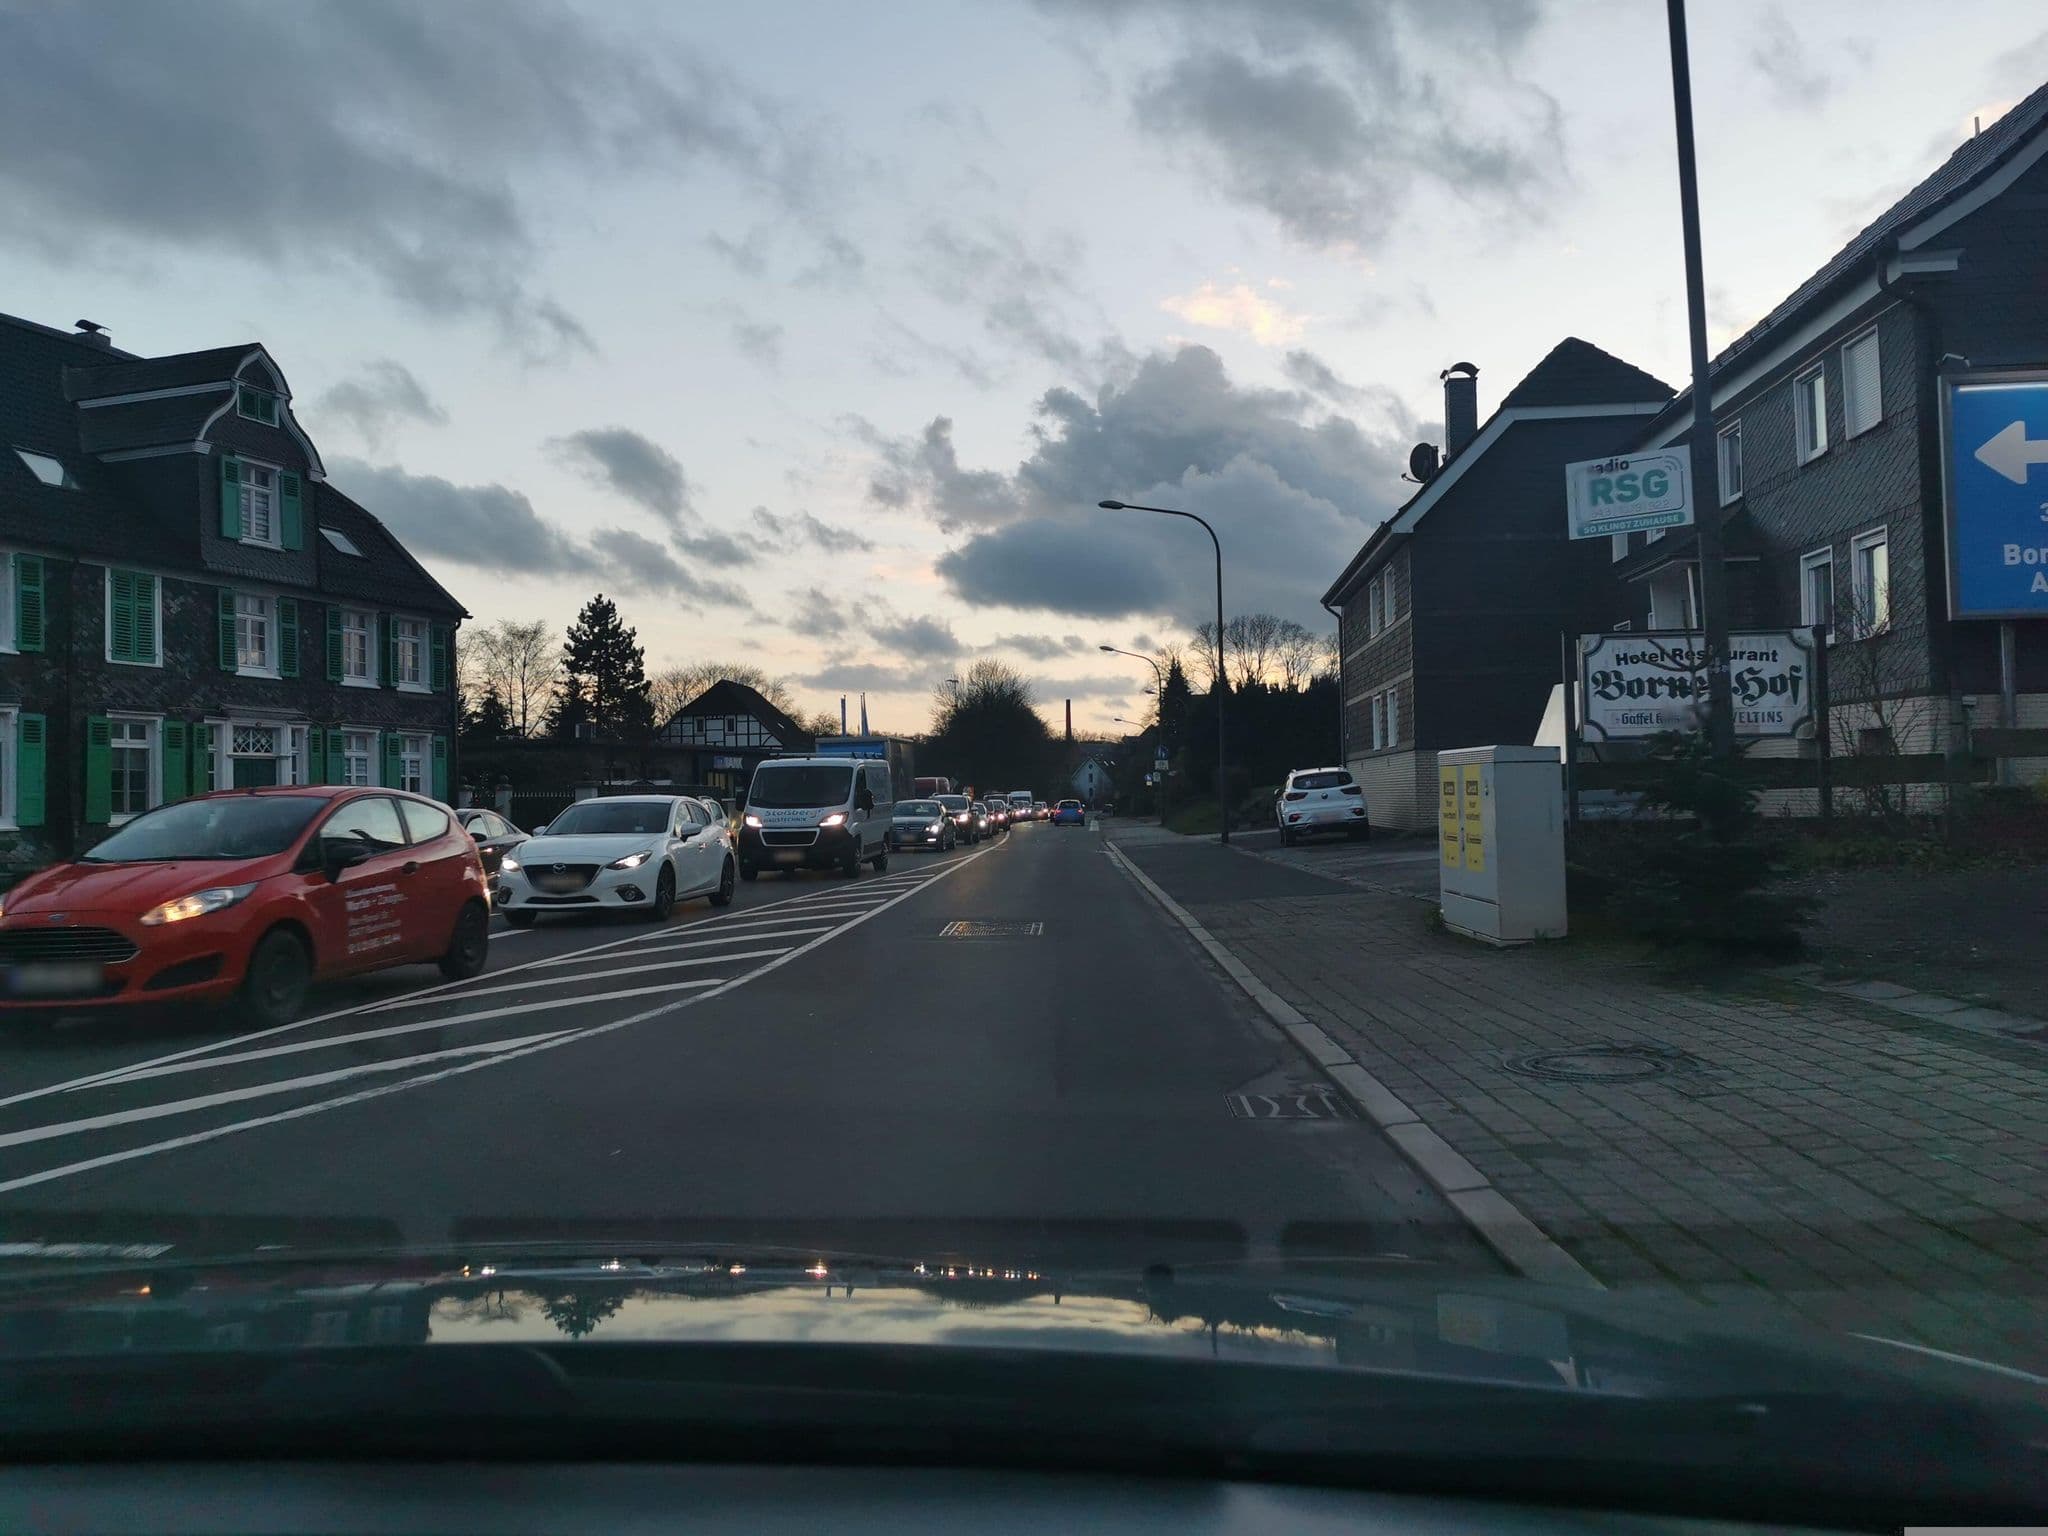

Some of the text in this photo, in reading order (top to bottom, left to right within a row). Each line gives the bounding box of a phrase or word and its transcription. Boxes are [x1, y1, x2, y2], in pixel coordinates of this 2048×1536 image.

[1589, 469, 1669, 507] RSG
[1633, 514, 1680, 529] ZUHAUSE
[1615, 648, 1778, 666] Hotel Resurant
[1591, 665, 1803, 707] Borne Hof
[1621, 712, 1655, 726] Gaffel
